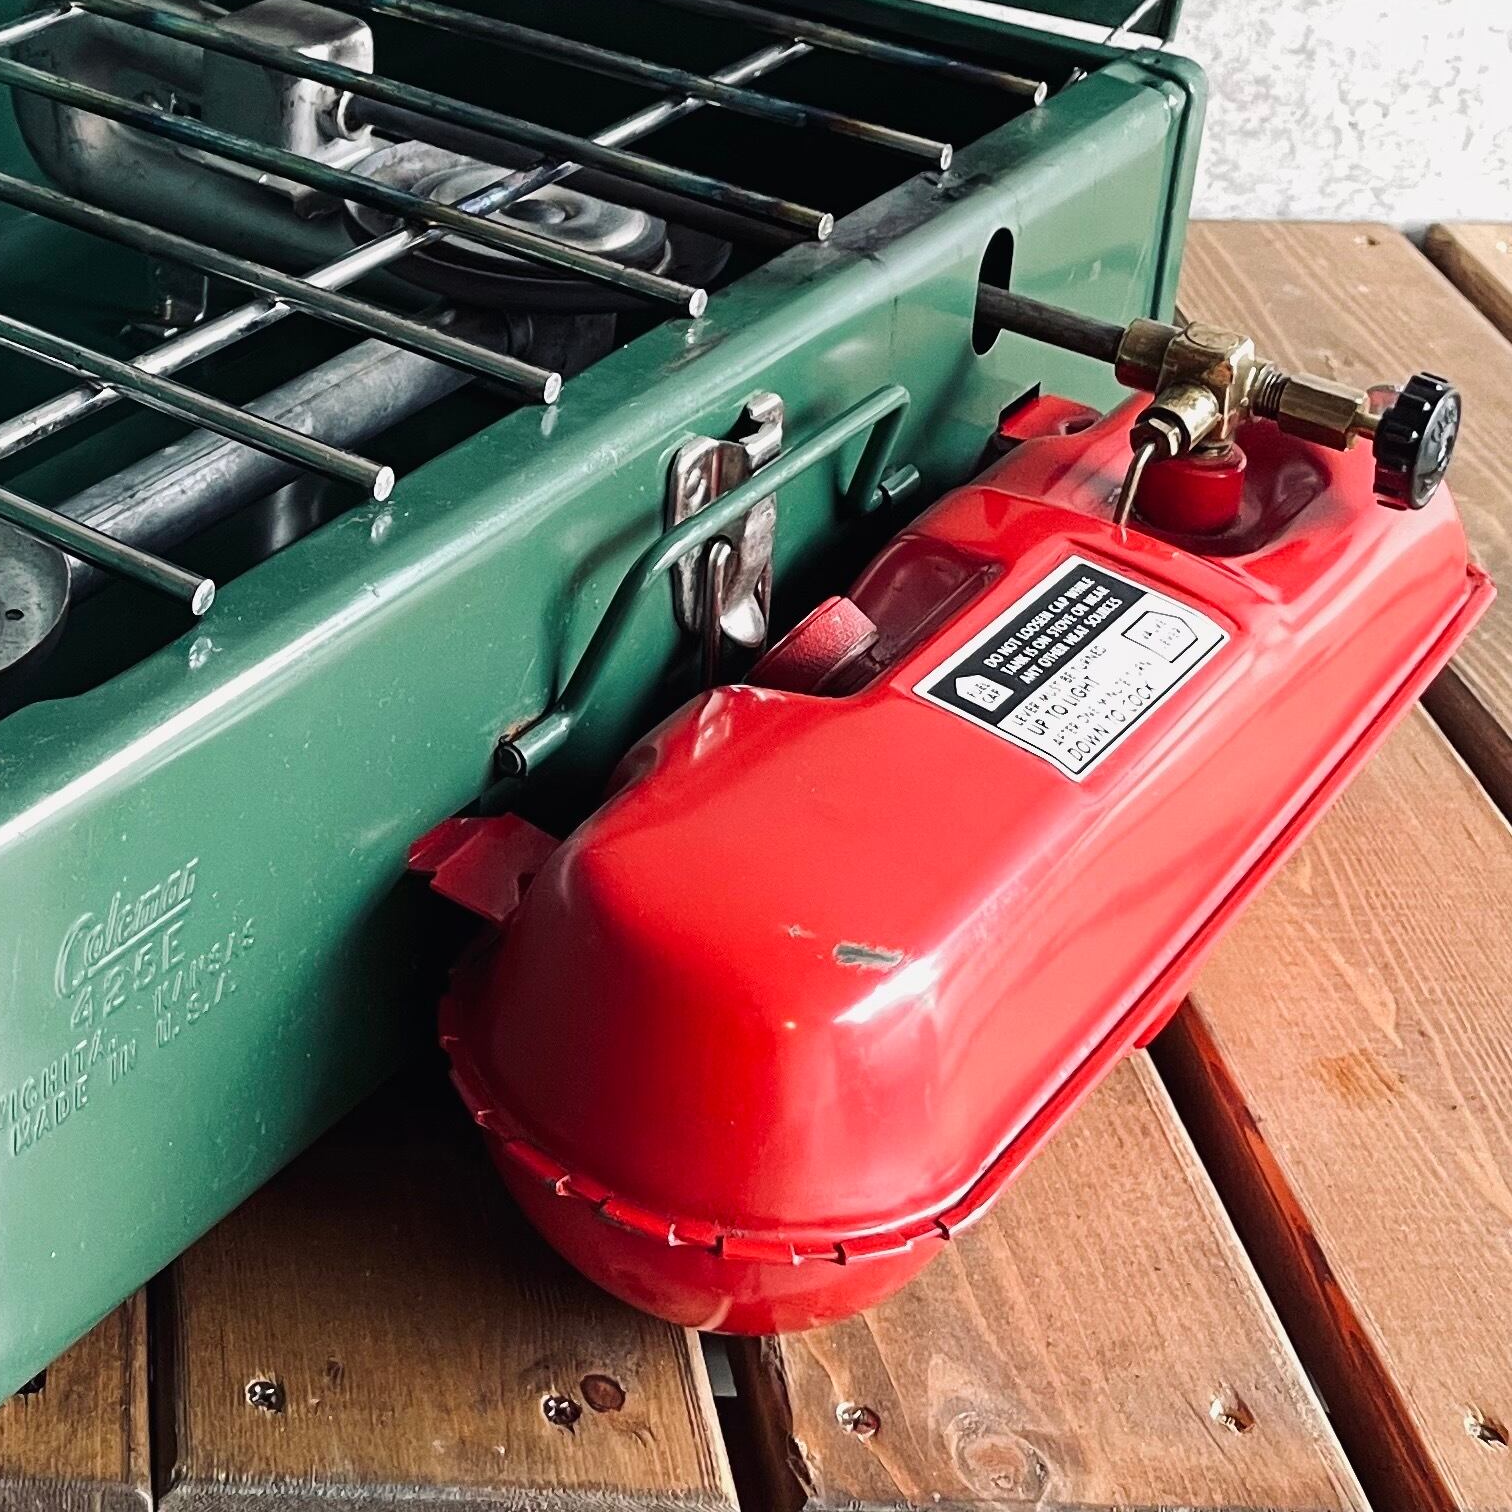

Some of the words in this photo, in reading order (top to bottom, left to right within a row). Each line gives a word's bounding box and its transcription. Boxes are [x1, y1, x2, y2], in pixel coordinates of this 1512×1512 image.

[983, 654, 1004, 668] DO
[997, 637, 1022, 656] NOT
[1016, 611, 1054, 640] LOOSEN
[1048, 597, 1069, 612] CAP
[1064, 577, 1095, 599] WHILE
[1000, 654, 1031, 675] TANK
[1023, 646, 1038, 657] IS
[1032, 635, 1052, 649] ON
[1046, 613, 1077, 637] STOVE
[1071, 603, 1090, 616] OR
[1083, 586, 1110, 606] NEAR
[1018, 665, 1043, 684] ANY
[1038, 643, 1070, 667] OTHER
[1063, 625, 1089, 646] HEAT
[1084, 597, 1123, 627] SOURCES
[1027, 719, 1049, 735] UP
[1045, 705, 1068, 719] TO
[1062, 676, 1100, 706] LIGHT
[1068, 724, 1109, 761] DOWN
[1105, 710, 1126, 724] TO
[55, 857, 198, 1000] Coleman
[71, 921, 184, 1030] 425E
[11, 1075, 88, 1156] MADE
[111, 1039, 136, 1084] IN
